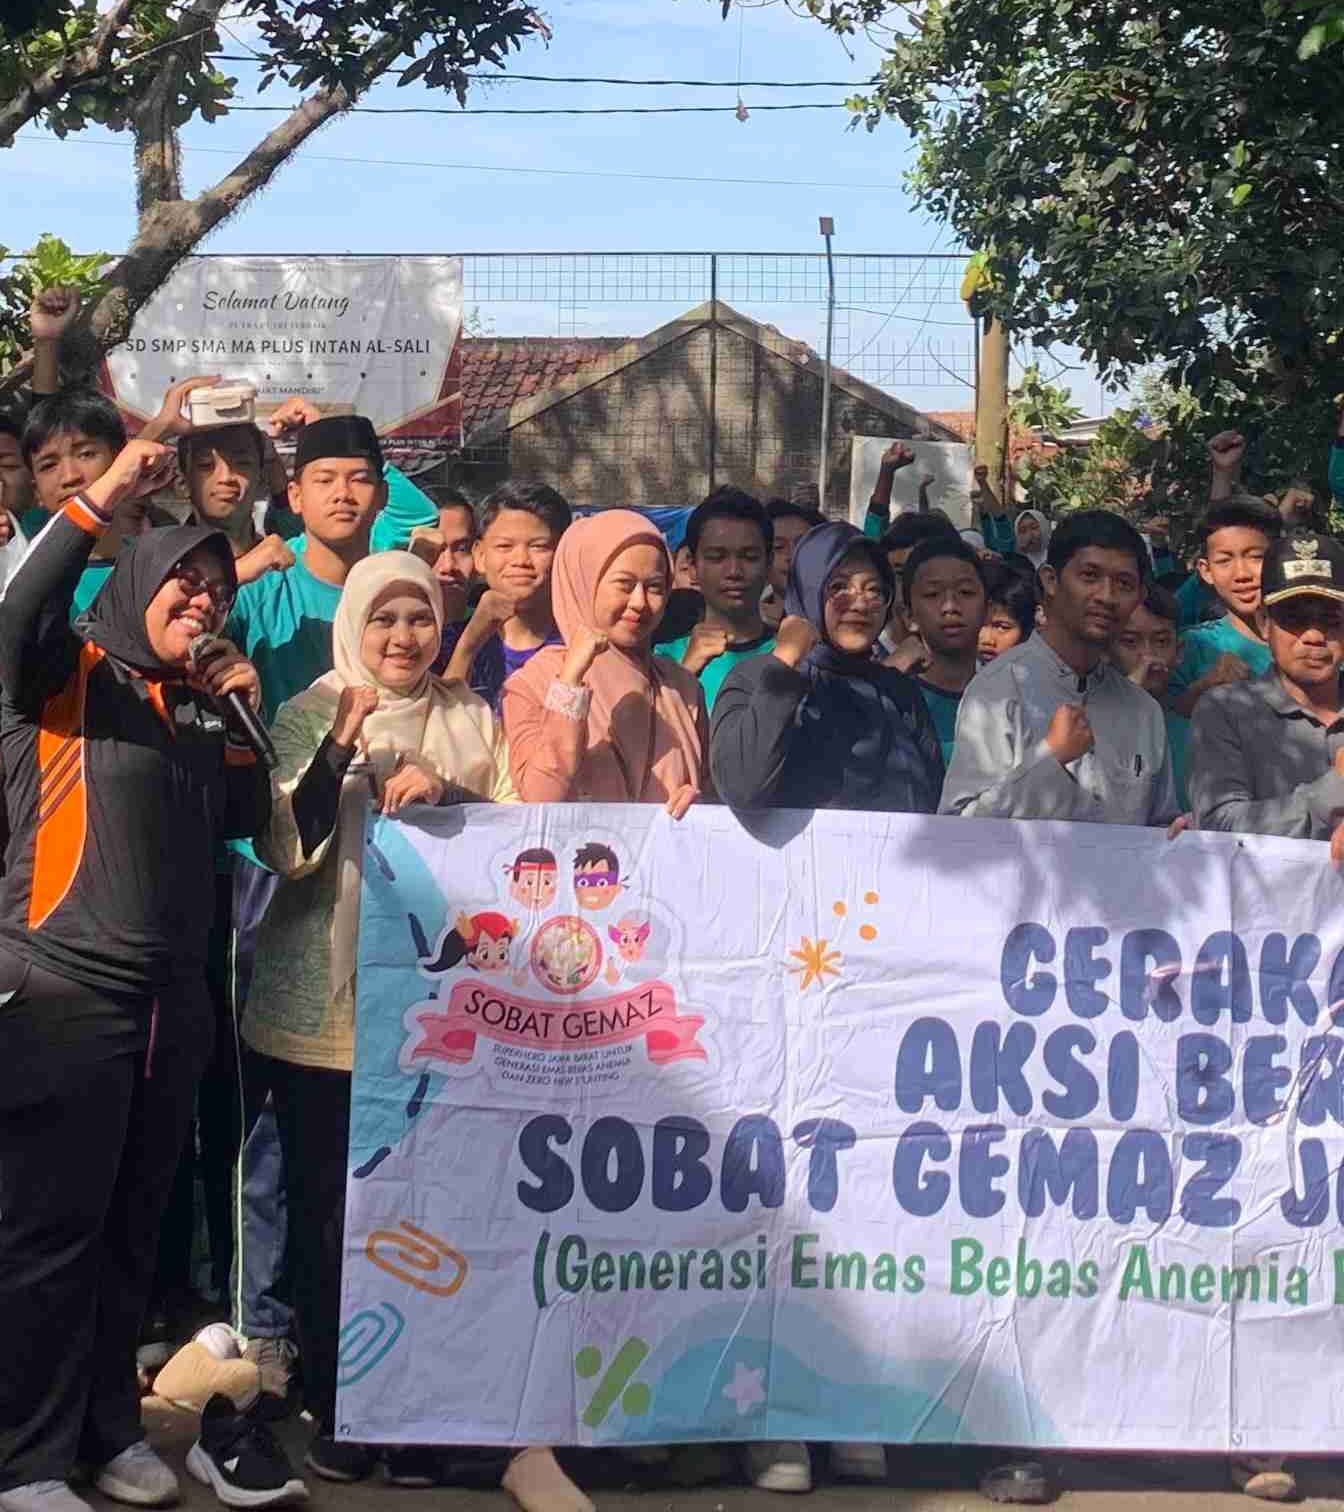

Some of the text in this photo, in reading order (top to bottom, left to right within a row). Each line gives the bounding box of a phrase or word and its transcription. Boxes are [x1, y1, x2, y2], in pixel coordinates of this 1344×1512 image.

[203, 289, 351, 317] Selamat Datang
[126, 338, 430, 353] SD SMP SMA MA PLUS INTAN AL-SALI
[464, 989, 663, 1039] SOBAT GEMAZ
[894, 1015, 1141, 1122] AKSI
[516, 1113, 857, 1215] SOBAT
[892, 1120, 1243, 1229] GEMAZ
[532, 1231, 768, 1309] (Generasi
[791, 1233, 927, 1294] Emas
[949, 1237, 1099, 1300] Bebas
[1118, 1243, 1310, 1306] Anemia
